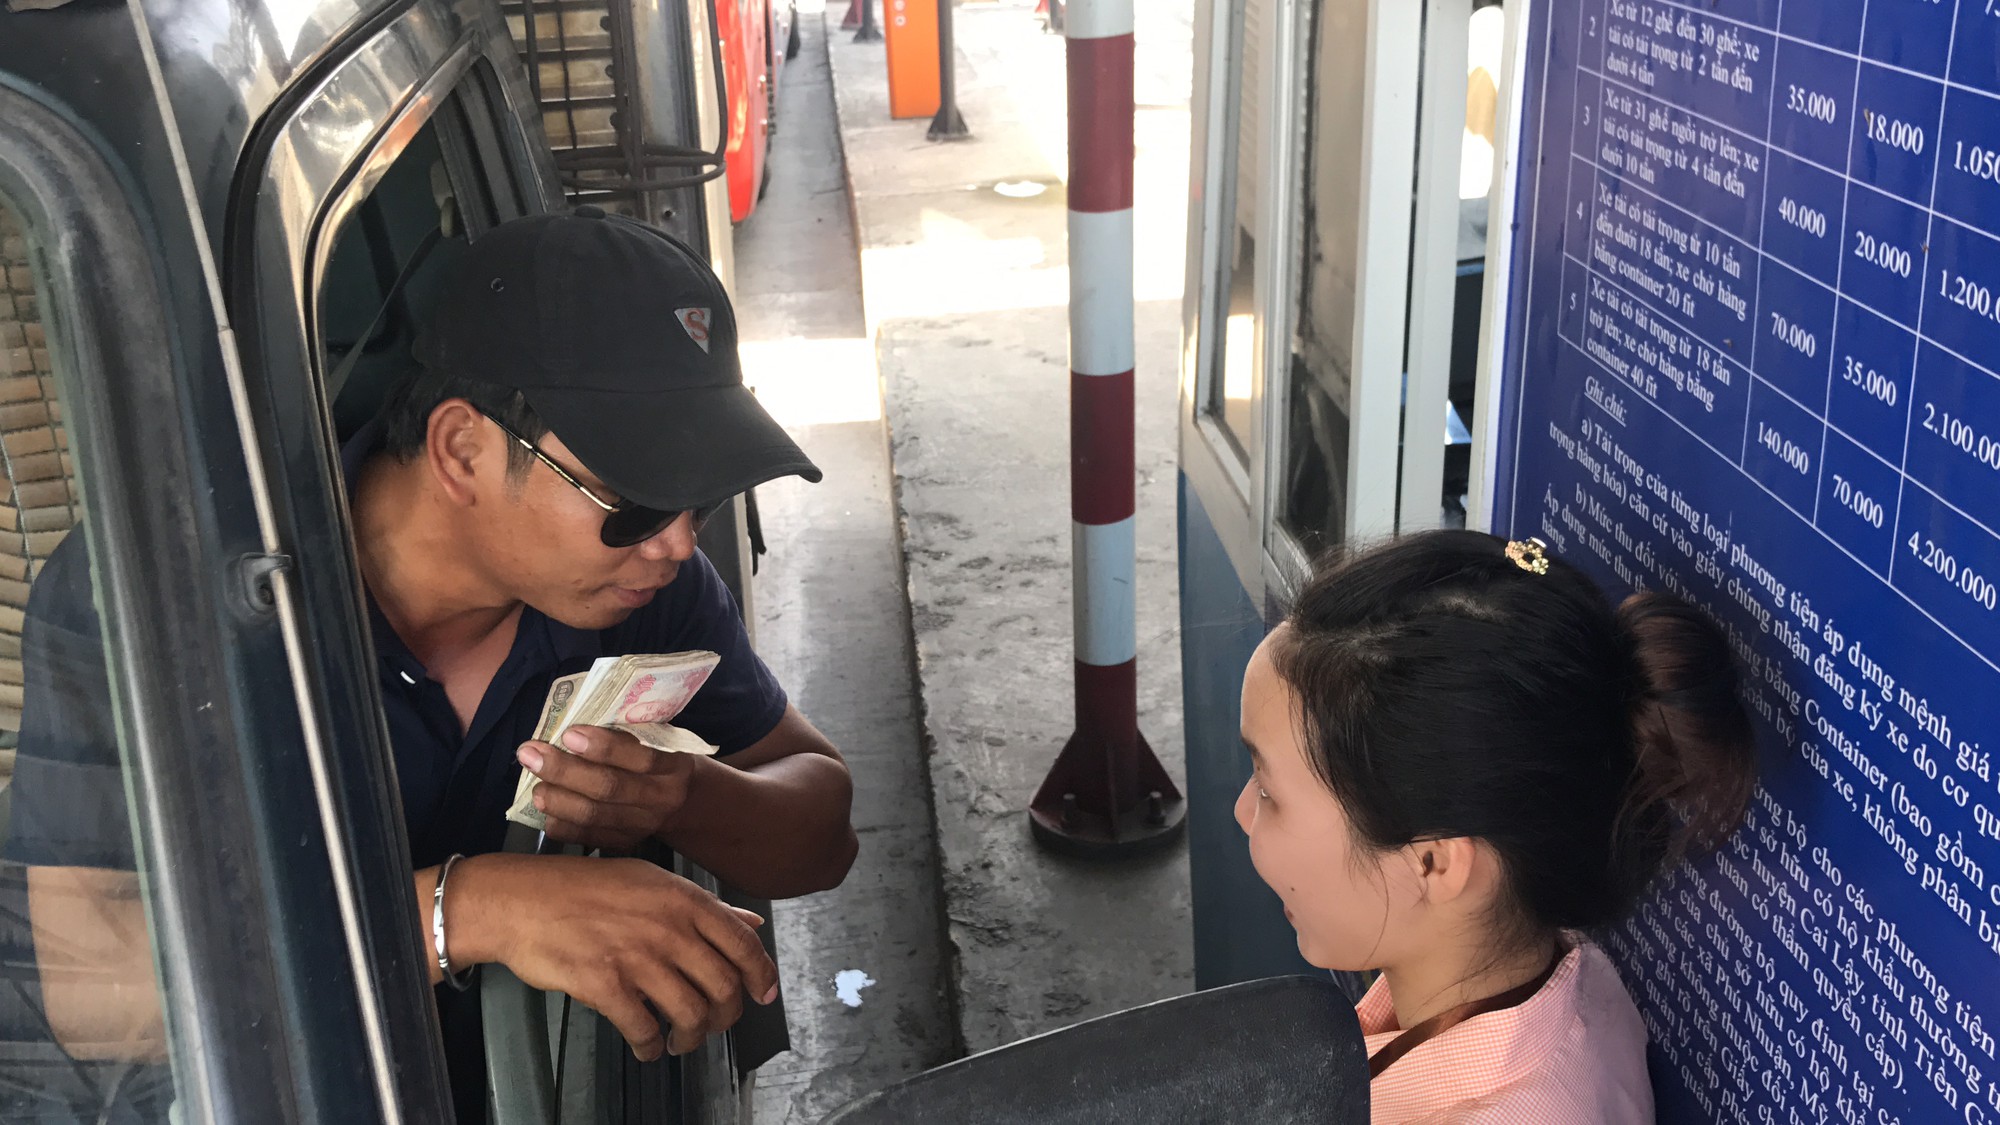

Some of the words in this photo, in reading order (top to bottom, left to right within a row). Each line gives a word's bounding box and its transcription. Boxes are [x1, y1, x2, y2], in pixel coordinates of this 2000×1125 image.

[1589, 16, 1596, 37] 2
[1641, 5, 1653, 27] 12
[1699, 23, 1714, 47] 30
[1744, 43, 1759, 62] xe
[1630, 61, 1637, 79] 4
[1698, 54, 1706, 76] 2
[1583, 105, 1590, 126] 3
[1605, 88, 1619, 110] Xe
[1621, 96, 1632, 116] từ
[1634, 100, 1646, 122] 31
[1648, 107, 1669, 132] ghế
[1671, 115, 1696, 144] ngồi
[1700, 130, 1717, 153] trở
[1719, 135, 1741, 172] lên;
[1743, 152, 1759, 172] xe
[1787, 84, 1836, 124] 35.000
[1867, 112, 1924, 155] 18.000
[1626, 153, 1638, 174] 10
[1691, 156, 1699, 176] 4
[1576, 202, 1583, 220] 4
[1599, 182, 1613, 207] Xe
[1614, 194, 1627, 215] tải
[1628, 202, 1641, 222] có
[1643, 209, 1656, 232] tải
[1658, 218, 1688, 254] trọng
[1690, 233, 1701, 256] từ
[1705, 240, 1720, 266] 10
[1722, 246, 1740, 279] tấn
[1778, 197, 1826, 238] 40.000
[1594, 238, 1617, 274] bằng
[1618, 260, 1664, 298] container
[1665, 283, 1680, 308] 20
[1682, 293, 1695, 318] fit
[1596, 210, 1613, 238] đến
[1615, 223, 1637, 252] dưới
[1640, 236, 1652, 260] 18
[1654, 241, 1673, 276] tấn;
[1675, 262, 1690, 282] xe
[1693, 269, 1715, 296] chở
[1717, 280, 1746, 322] hàng
[1854, 231, 1911, 278] 20.000
[685, 309, 708, 341] S
[1570, 292, 1576, 310] 5
[1591, 277, 1606, 302] Xe
[1607, 290, 1619, 312] tải
[1621, 300, 1633, 320] có
[1635, 308, 1648, 330] tải
[1650, 318, 1677, 354] trọng
[1679, 337, 1692, 359] từ
[1696, 346, 1710, 371] 18
[1712, 358, 1730, 386] tấn
[1589, 308, 1603, 329] trở
[1604, 315, 1622, 346] lên;
[1623, 333, 1636, 353] xe
[1637, 341, 1657, 367] chở
[1658, 351, 1685, 391] hàng
[1686, 371, 1714, 413] bằng
[1772, 312, 1815, 358] 70.000
[1585, 376, 1604, 403] Ghi
[1604, 393, 1627, 423] chú:
[1587, 337, 1630, 378] container
[1631, 365, 1644, 388] 40
[1645, 375, 1657, 399] fit
[1843, 356, 1896, 406] 35.000
[1758, 422, 1809, 475] 140.000
[1923, 402, 2000, 470] 2.100.00
[1542, 512, 1567, 554] hàng.
[1833, 474, 1883, 528] 70.000
[1581, 418, 1592, 441] a)
[1595, 423, 1612, 456] Tải
[1614, 444, 1644, 487] trọng
[1646, 474, 1668, 502] của
[1671, 490, 1700, 534] từng
[1703, 513, 1729, 554] loại
[1730, 544, 1786, 608] phương
[1790, 592, 1819, 633] tiện
[1823, 619, 1844, 657] áp
[1848, 641, 1895, 702] dụng
[1898, 688, 1951, 750] mệnh
[1956, 742, 1990, 782] giá
[1908, 531, 1996, 610] 4.200.000
[1550, 421, 1575, 460] trọng
[1576, 440, 1601, 483] hàng
[1603, 464, 1627, 504] hóa)
[1629, 493, 1649, 521] căn
[1652, 513, 1668, 536] cứ
[1671, 527, 1693, 557] vào
[1695, 548, 1725, 589] giấy
[1728, 577, 1771, 633] chứng
[1774, 620, 1810, 666] nhận
[1814, 653, 1856, 710] đăng
[1859, 689, 1883, 731] ký
[1886, 720, 1909, 753] xe
[1913, 744, 1937, 780] do
[1942, 775, 1969, 807] cơ
[1544, 483, 1559, 516] Áp
[1562, 504, 1586, 544] dụng
[1589, 533, 1611, 565] mức
[1614, 555, 1631, 585] thu
[1801, 742, 1828, 779] của
[1832, 771, 1857, 812] xe,
[1862, 793, 1919, 875] không
[1921, 863, 1971, 926] phân
[1576, 483, 1587, 511] b)
[1588, 495, 1612, 533] Mức
[1615, 523, 1632, 552] thu
[1635, 541, 1655, 572] đối
[1765, 657, 1801, 715] bằng
[1805, 699, 1888, 792] Container
[1891, 782, 1932, 837] (bao
[1935, 831, 1983, 891] gồm
[1759, 826, 1778, 852] sở
[1780, 842, 1809, 892] hữu
[1813, 888, 1833, 917] có
[1837, 906, 1858, 949] hộ
[1862, 935, 1904, 1003] khẩu
[1910, 995, 1982, 1094] thường
[1787, 810, 1807, 851] bộ
[1812, 847, 1842, 886] cho
[1846, 884, 1874, 923] các
[1876, 918, 1950, 1014] phương
[1956, 1001, 1995, 1060] tiện
[1680, 889, 1701, 924] của
[1706, 923, 1729, 961] chủ
[1734, 960, 1752, 986] sở
[1756, 980, 1784, 1032] hữu
[1787, 1029, 1805, 1058] có
[1809, 1049, 1830, 1093] hộ
[1709, 890, 1754, 958] đường
[1756, 942, 1775, 983] bộ
[1779, 981, 1809, 1023] quy
[1811, 1018, 1847, 1076] định
[1853, 1070, 1875, 1114] tại
[1716, 851, 1748, 898] quan
[1752, 893, 1769, 920] có
[1772, 914, 1809, 972] thẩm
[1813, 968, 1863, 1036] quyền
[1865, 1033, 1907, 1094] cấp).
[1752, 849, 1796, 928] huyện
[1800, 908, 1828, 954] Cai
[1831, 940, 1866, 1004] Lậy,
[1872, 994, 1907, 1051] tỉnh
[1914, 1037, 1957, 1110] Tiền
[1643, 903, 1677, 963] Giang
[1680, 951, 1719, 1021] không
[1722, 1012, 1759, 1072] thuộc
[1761, 1069, 1786, 1111] đối
[1655, 960, 1676, 992] ghi
[1677, 988, 1691, 1012] rõ
[1693, 1008, 1718, 1053] trên
[1721, 1046, 1754, 1102] Giấy
[1674, 916, 1695, 949] các
[1697, 945, 1713, 974] xã
[1715, 964, 1741, 1013] Phú
[1744, 1002, 1794, 1090] Nhuận,
[1799, 1076, 1828, 1125] Mỹ
